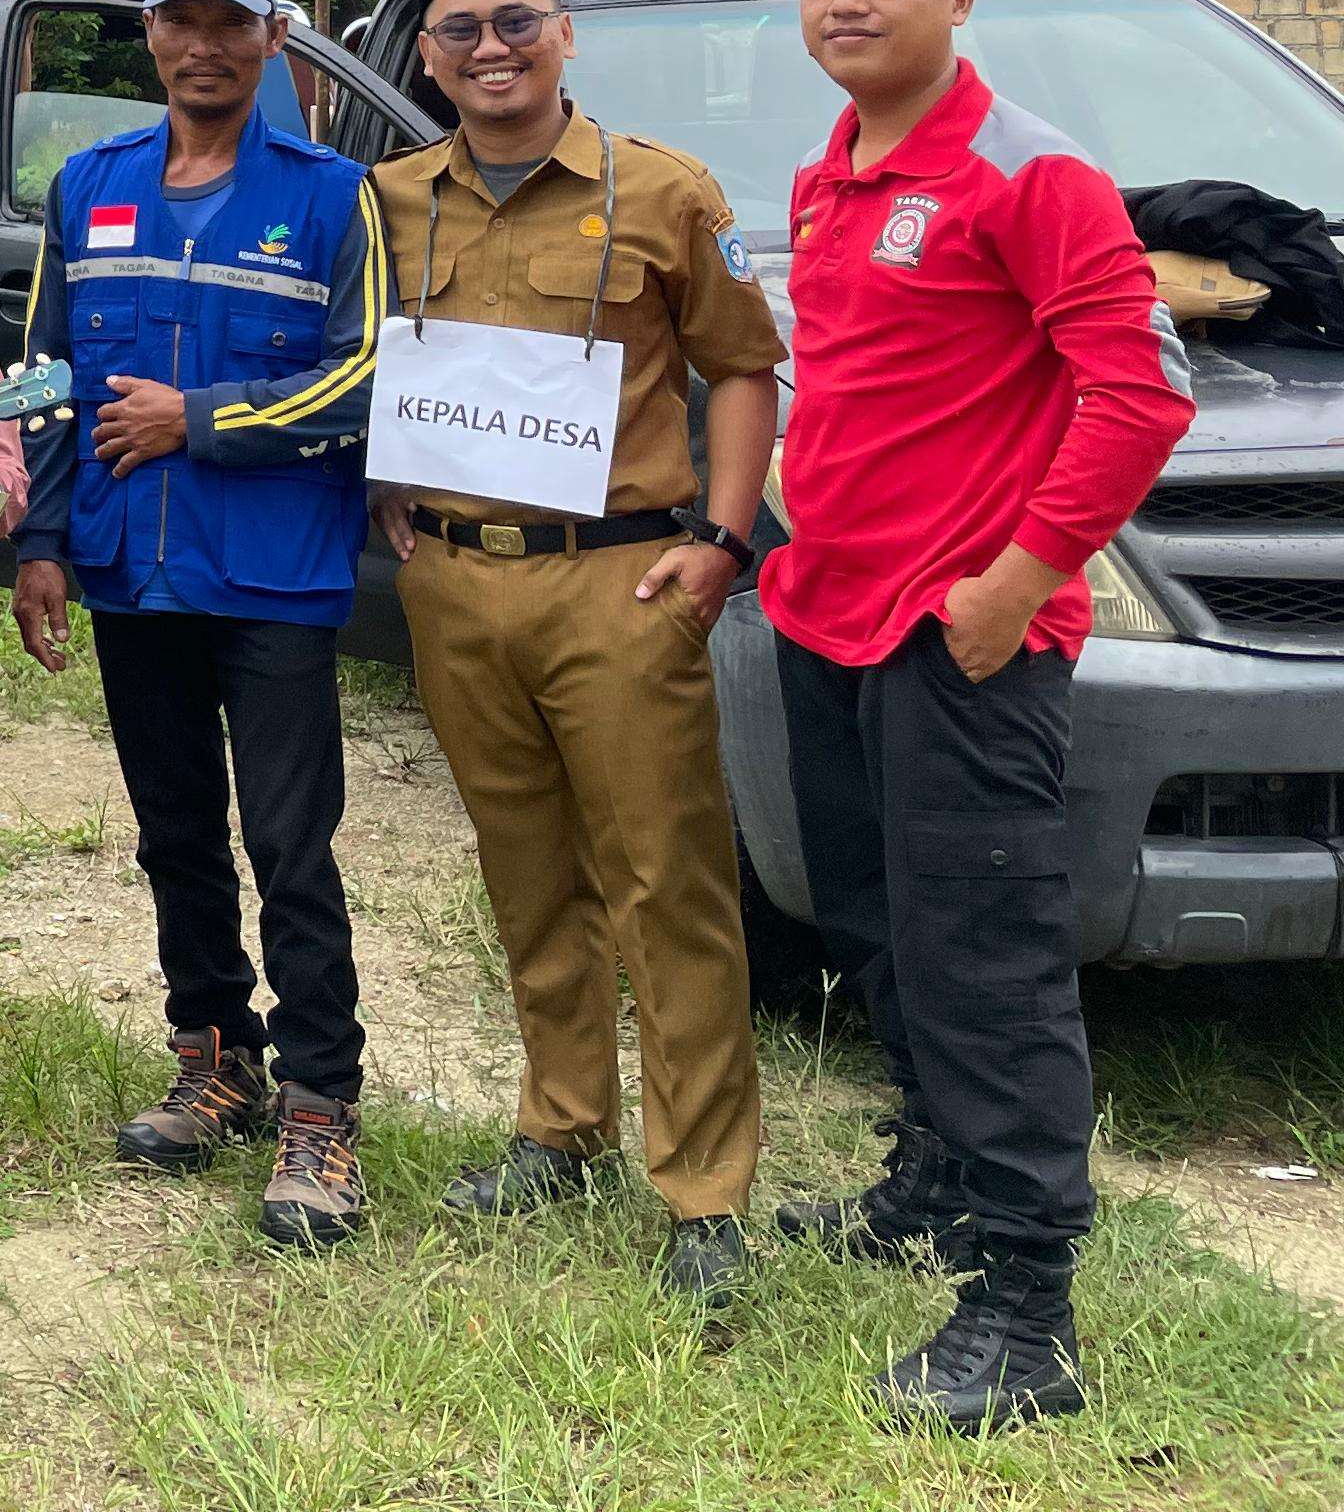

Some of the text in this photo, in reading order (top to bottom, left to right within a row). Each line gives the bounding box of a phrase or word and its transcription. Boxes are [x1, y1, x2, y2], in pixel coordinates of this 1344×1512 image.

[895, 196, 940, 213] TAGANA
[212, 269, 265, 286] TAGANA
[396, 394, 603, 453] KEPALA DESA
